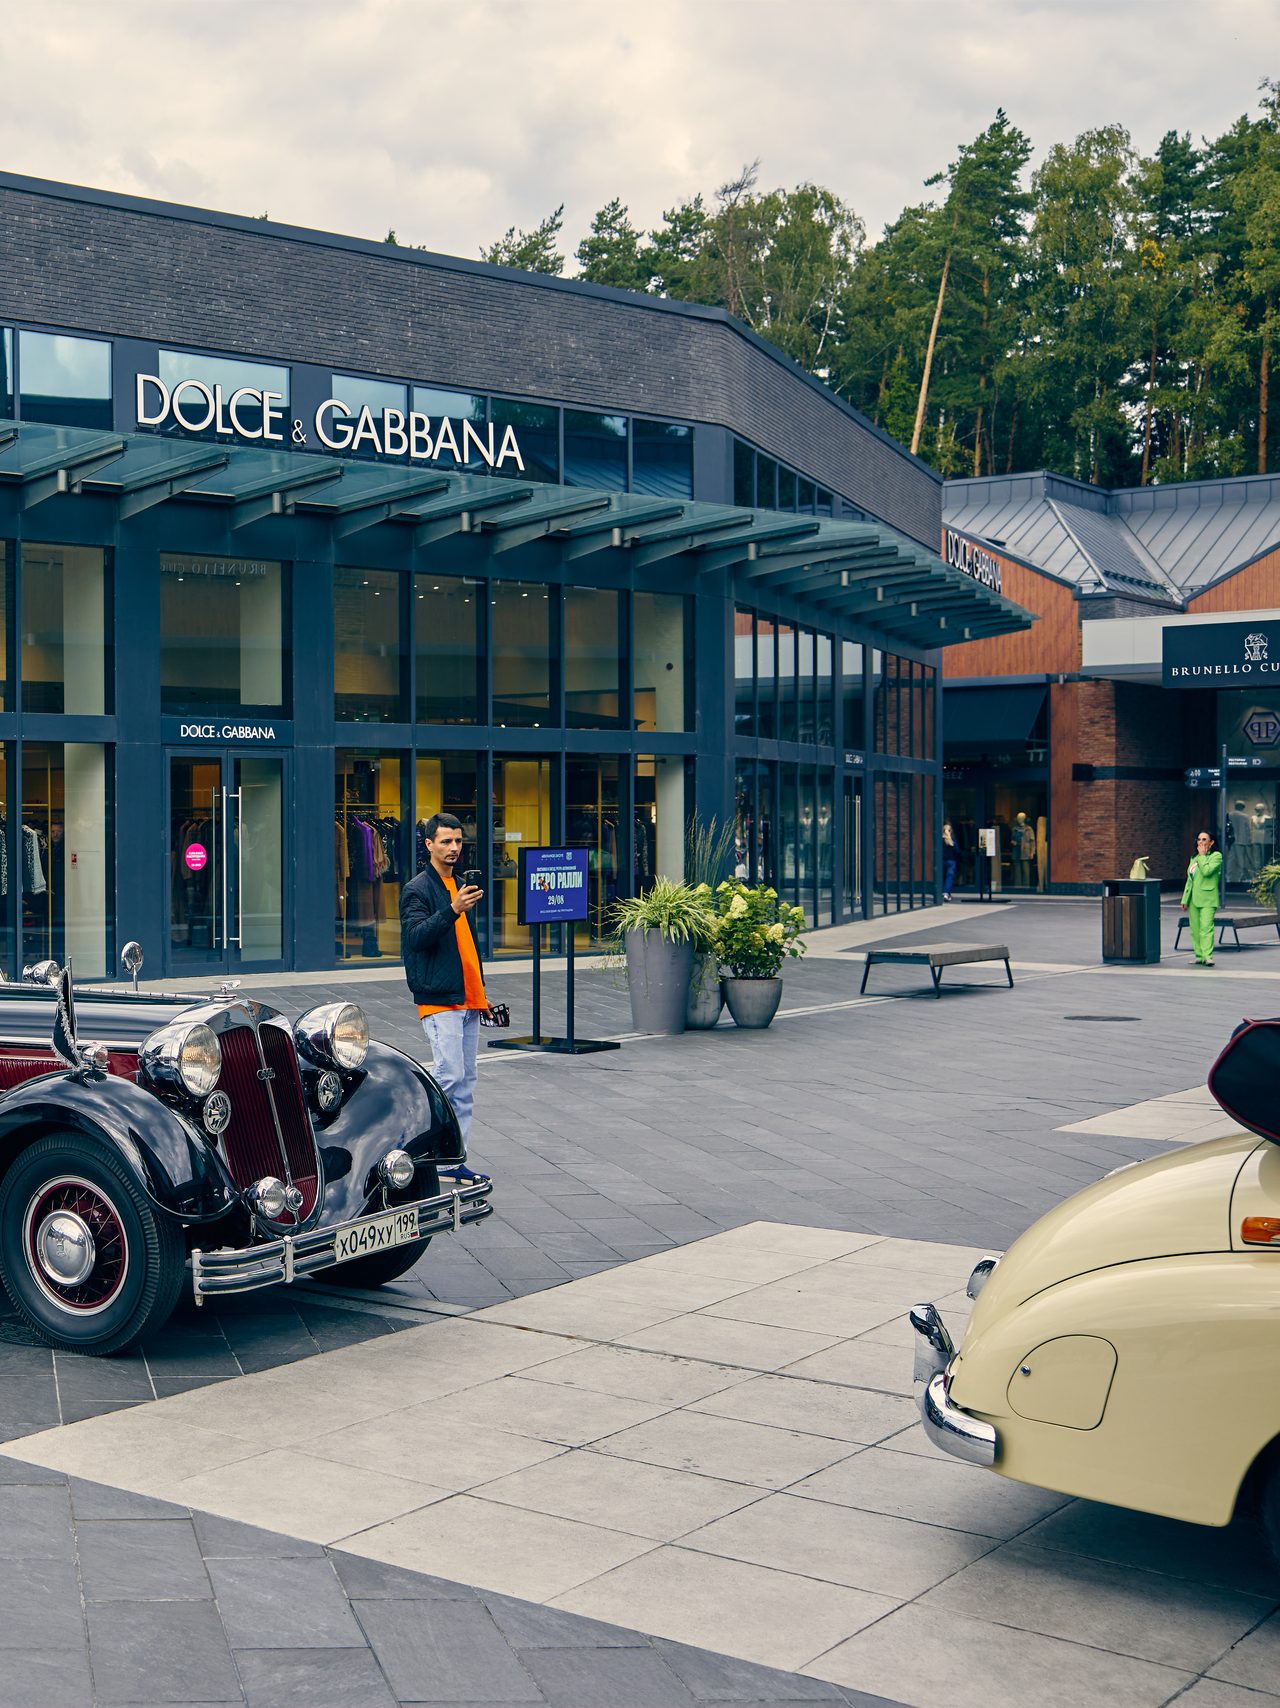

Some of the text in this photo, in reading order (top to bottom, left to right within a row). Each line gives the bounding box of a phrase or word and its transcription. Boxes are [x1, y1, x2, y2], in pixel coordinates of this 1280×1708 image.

[136, 373, 526, 472] DOLCE & GABBANA
[1171, 662, 1280, 676] BRUNELLO CU
[180, 724, 215, 738] DOLCE
[222, 725, 276, 739] GABBANA
[530, 871, 583, 891] РЕТРО РАЛЛИ
[396, 1212, 415, 1233] 199
[400, 1232, 410, 1240] RUS
